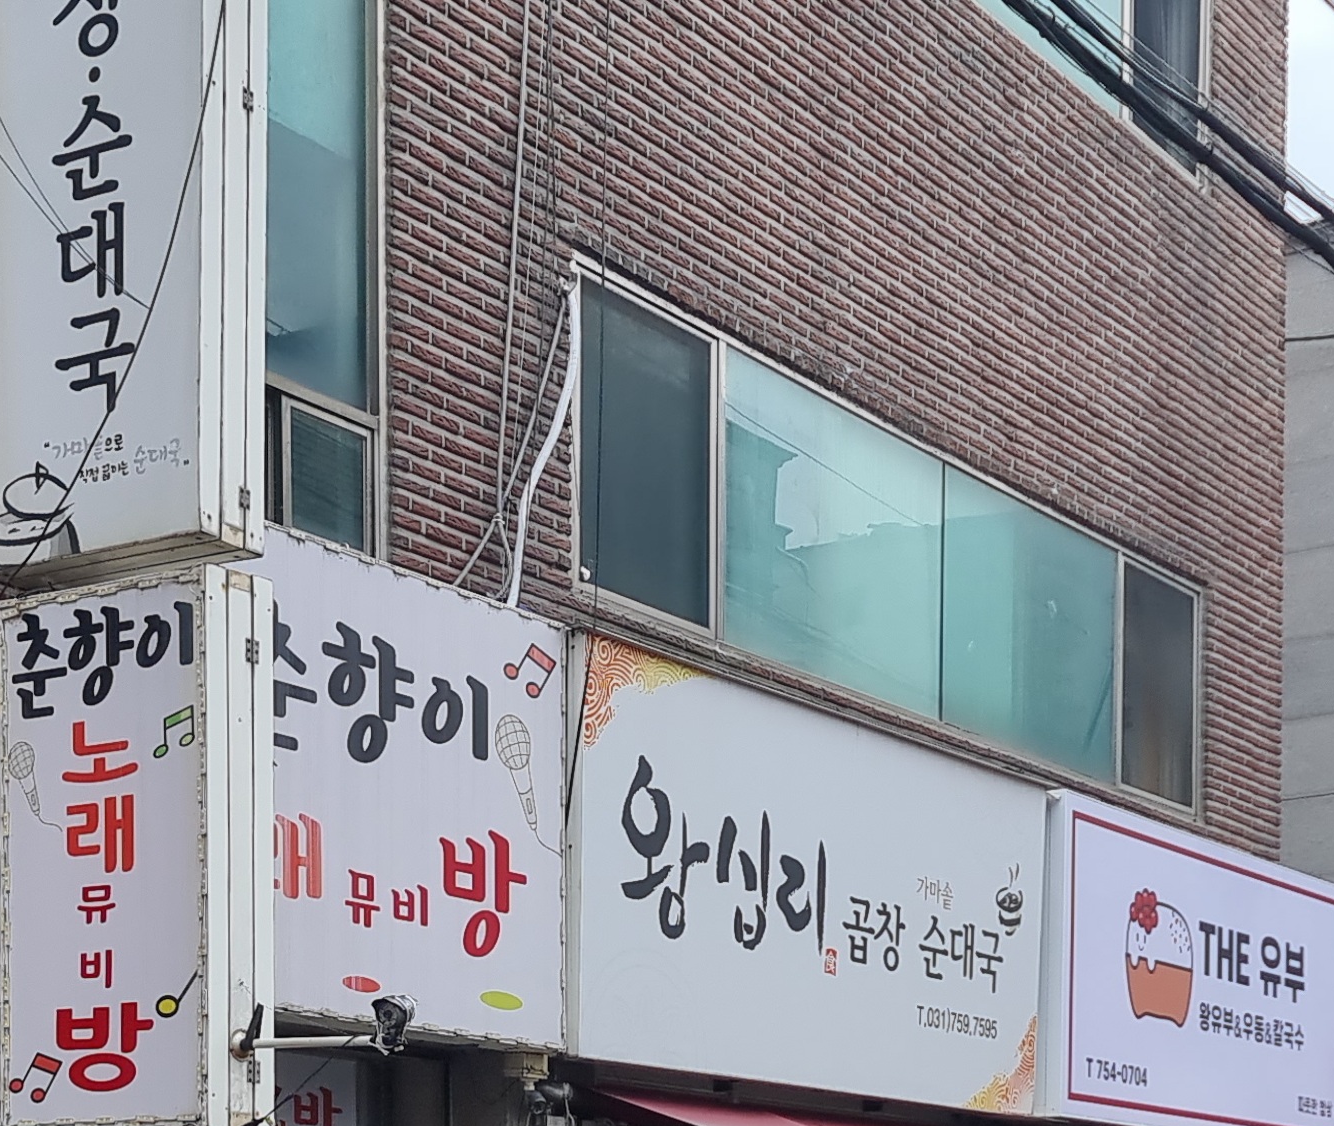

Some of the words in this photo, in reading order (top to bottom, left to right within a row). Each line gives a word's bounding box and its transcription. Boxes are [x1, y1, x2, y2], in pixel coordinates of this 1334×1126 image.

[12, 600, 194, 719] 춘향이
[621, 755, 827, 957] 왕십리
[916, 876, 954, 911] 가마솥
[842, 896, 906, 973] 곱창
[918, 916, 1004, 994] 순대국
[1199, 921, 1251, 987] THE
[1260, 936, 1305, 1004] 유부
[1199, 1002, 1304, 1051] 왕유부&우동&칼국수
[1086, 1057, 1094, 1078] T
[1097, 1060, 1148, 1087] 754-0704
